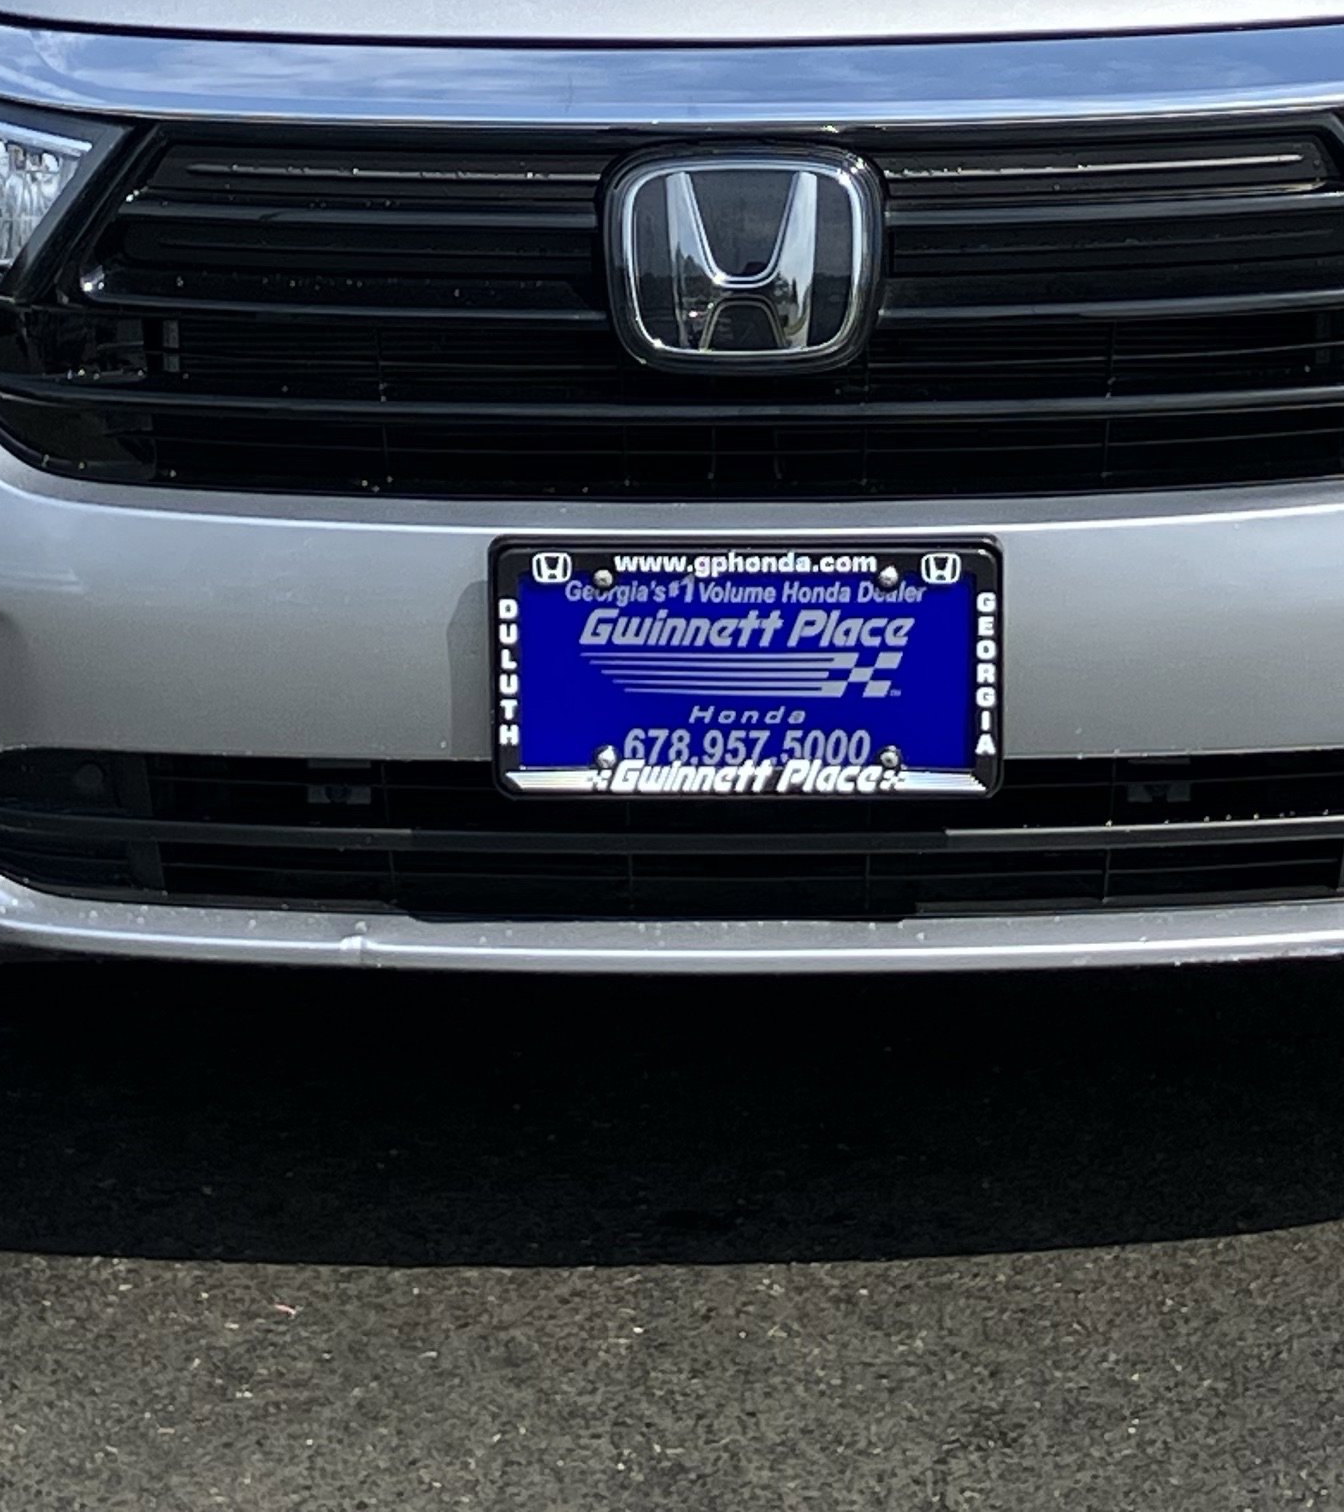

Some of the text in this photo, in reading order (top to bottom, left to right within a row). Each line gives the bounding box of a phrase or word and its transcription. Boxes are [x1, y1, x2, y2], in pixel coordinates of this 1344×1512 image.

[613, 550, 877, 577] www.gphonda.com
[564, 580, 667, 607] Georgia's
[698, 581, 777, 603] Volume
[781, 581, 852, 603] Honda
[856, 581, 927, 604] Dealer
[578, 608, 916, 648] Gwinnett Place
[499, 598, 519, 746] DULUTH
[975, 592, 996, 755] GEORGIA
[688, 705, 807, 725] Honda
[623, 728, 871, 766] 678.957.5000
[610, 759, 883, 793] Gwinnett Place
